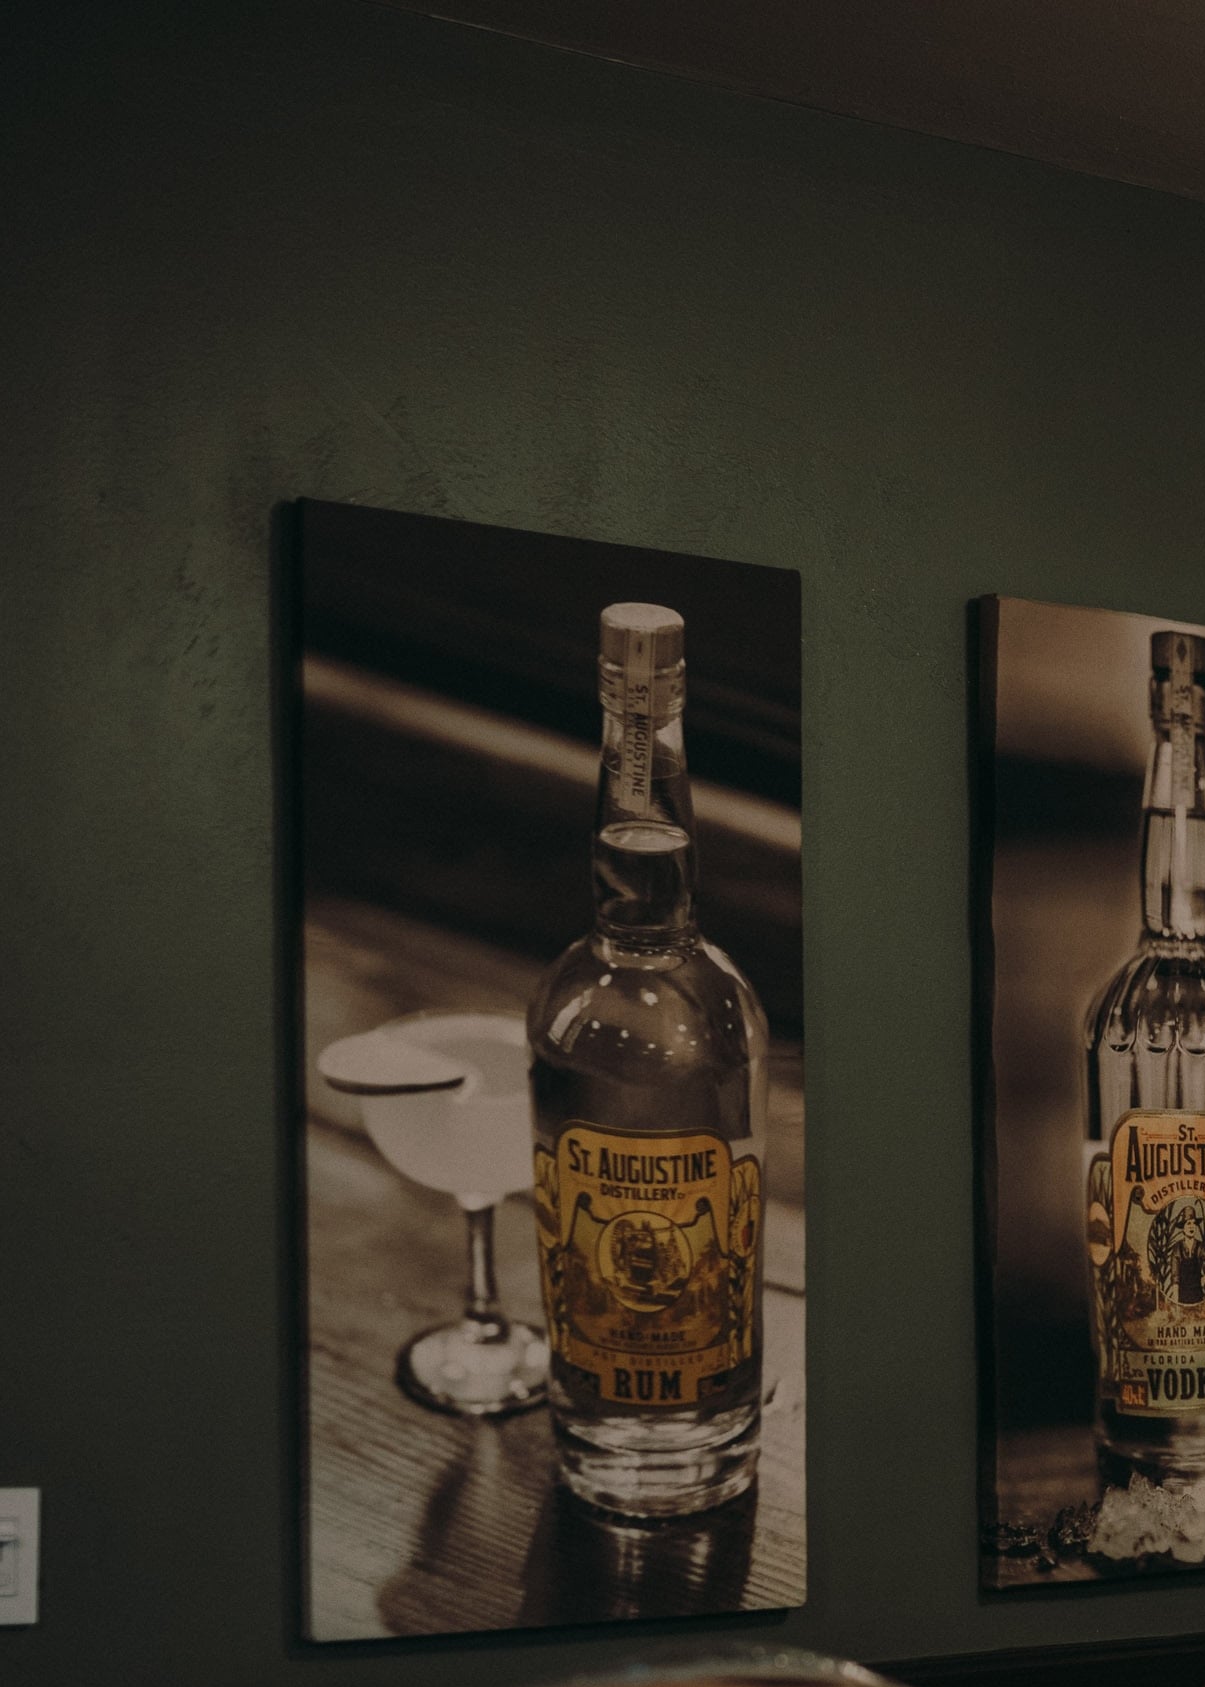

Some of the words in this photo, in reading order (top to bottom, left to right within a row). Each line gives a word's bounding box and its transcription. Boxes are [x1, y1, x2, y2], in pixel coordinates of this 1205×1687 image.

[632, 713, 648, 797] AUGUSTINE
[1178, 1124, 1198, 1141] ST.
[568, 1138, 593, 1176] ST.
[598, 1147, 717, 1184] AUGUSTINE
[600, 1182, 678, 1201] DISTILLERY
[1157, 1326, 1187, 1338] HAND
[1143, 1355, 1195, 1365] FLORIDA
[614, 1367, 682, 1400] RUM
